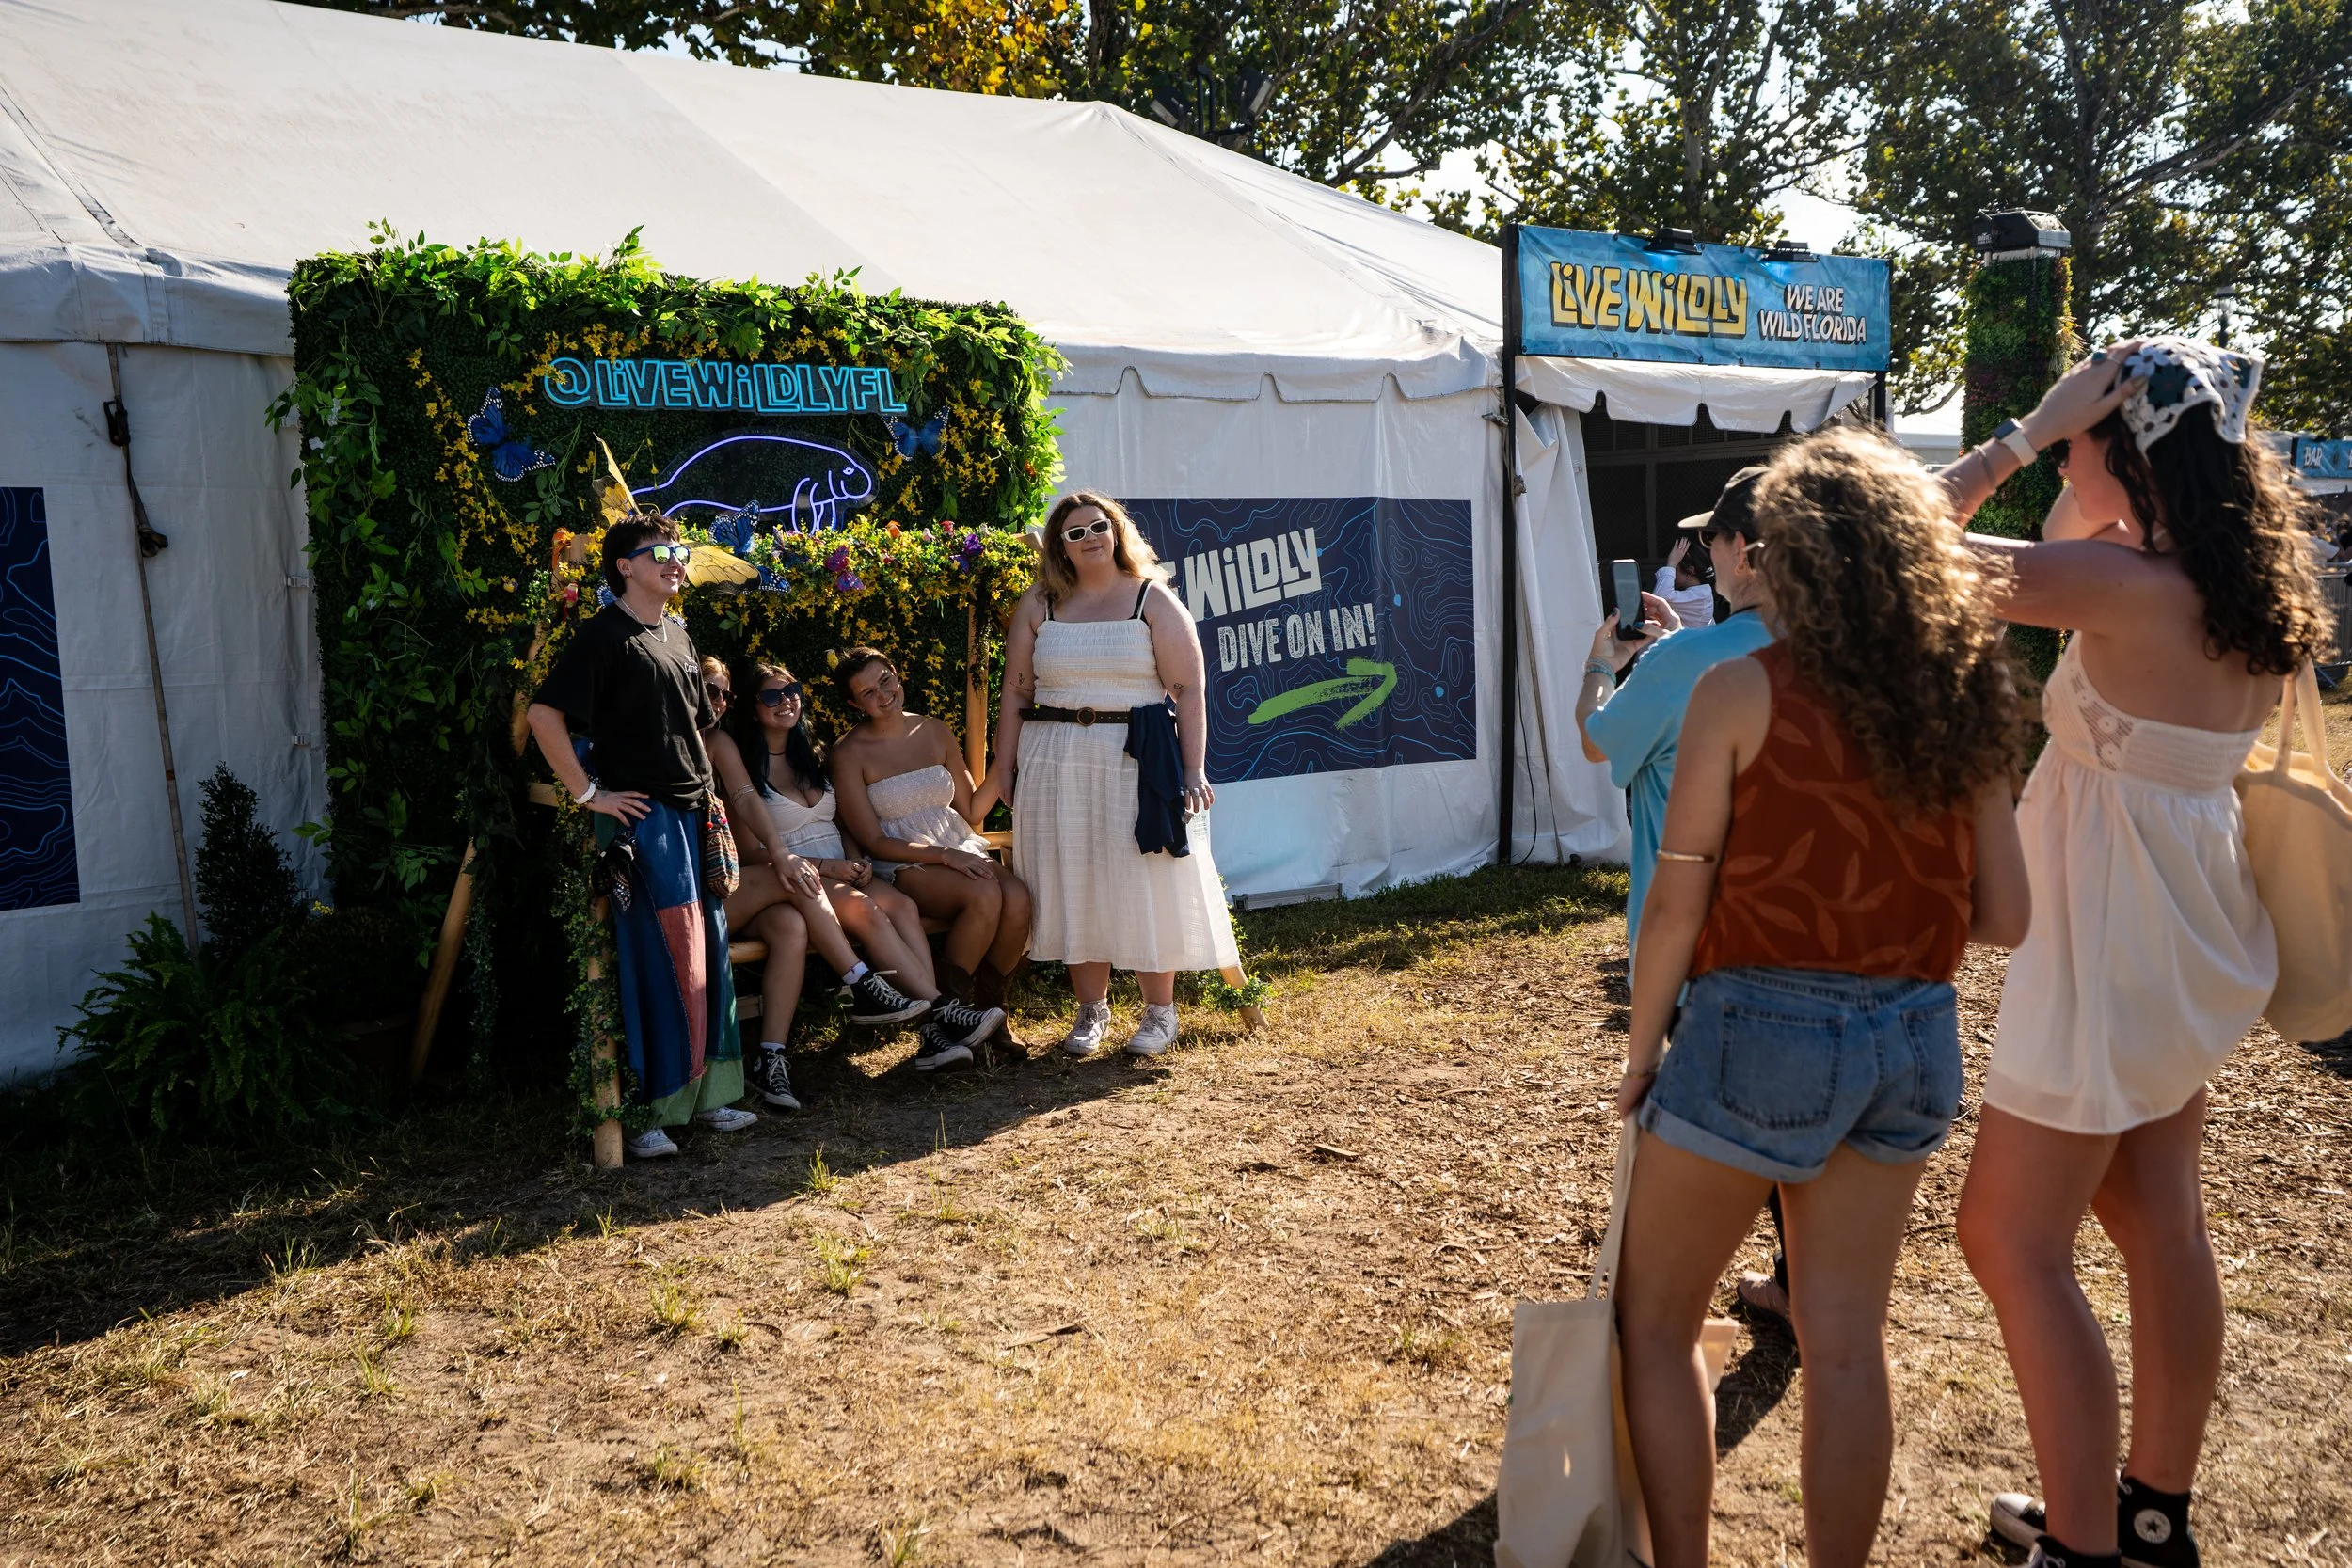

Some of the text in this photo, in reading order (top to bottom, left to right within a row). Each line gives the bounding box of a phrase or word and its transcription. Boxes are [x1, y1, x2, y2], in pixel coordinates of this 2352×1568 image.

[1549, 261, 1622, 330] LiVE
[1786, 283, 1845, 317] WE ARE
[1757, 309, 1867, 344] WILD FLORIDA
[2304, 445, 2323, 468] BAR
[1217, 602, 1377, 673] DIVE ON IN!
